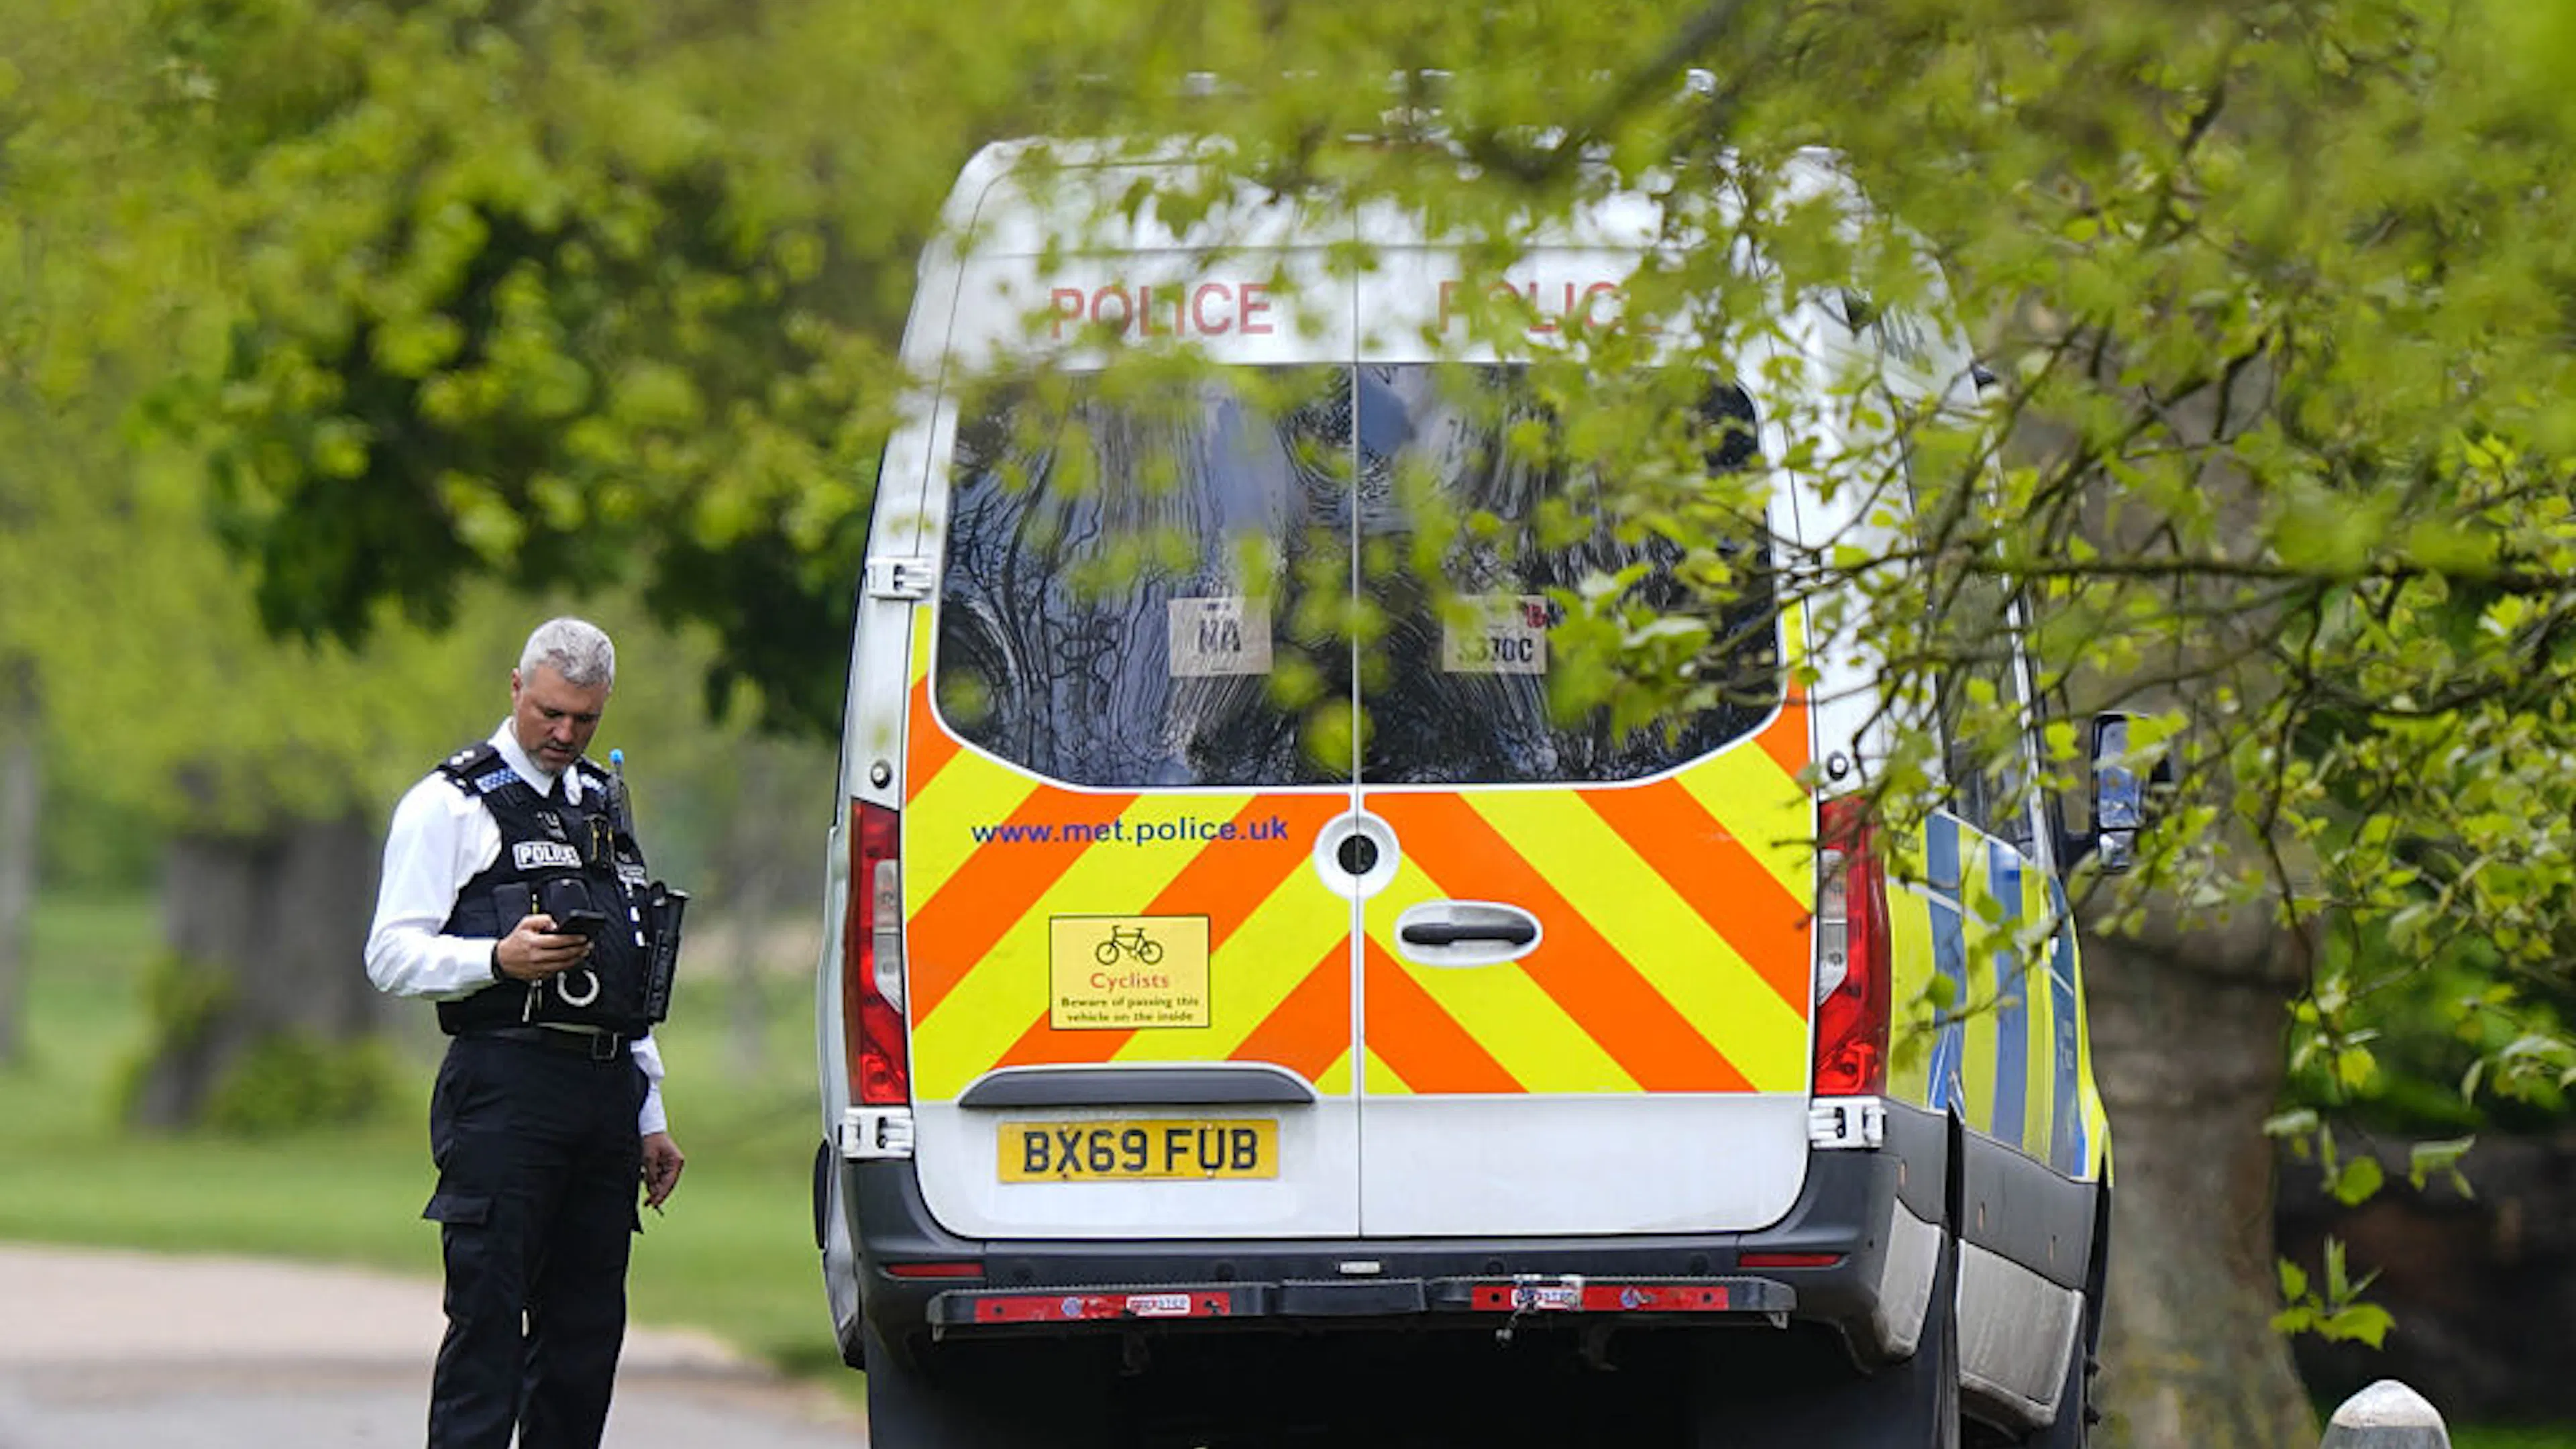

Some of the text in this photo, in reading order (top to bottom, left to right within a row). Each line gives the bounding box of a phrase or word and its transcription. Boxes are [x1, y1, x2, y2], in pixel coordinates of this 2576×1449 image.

[1051, 282, 1274, 339] POLICE
[1439, 280, 1662, 333] PLIC
[971, 816, 1288, 846] www.met.police.uk
[1090, 972, 1170, 993] Cyclists
[1061, 996, 1199, 1008] Beware of passing this
[1067, 1010, 1193, 1022] vehicle on the inside
[1024, 1128, 1258, 1173] BX69 FUB
